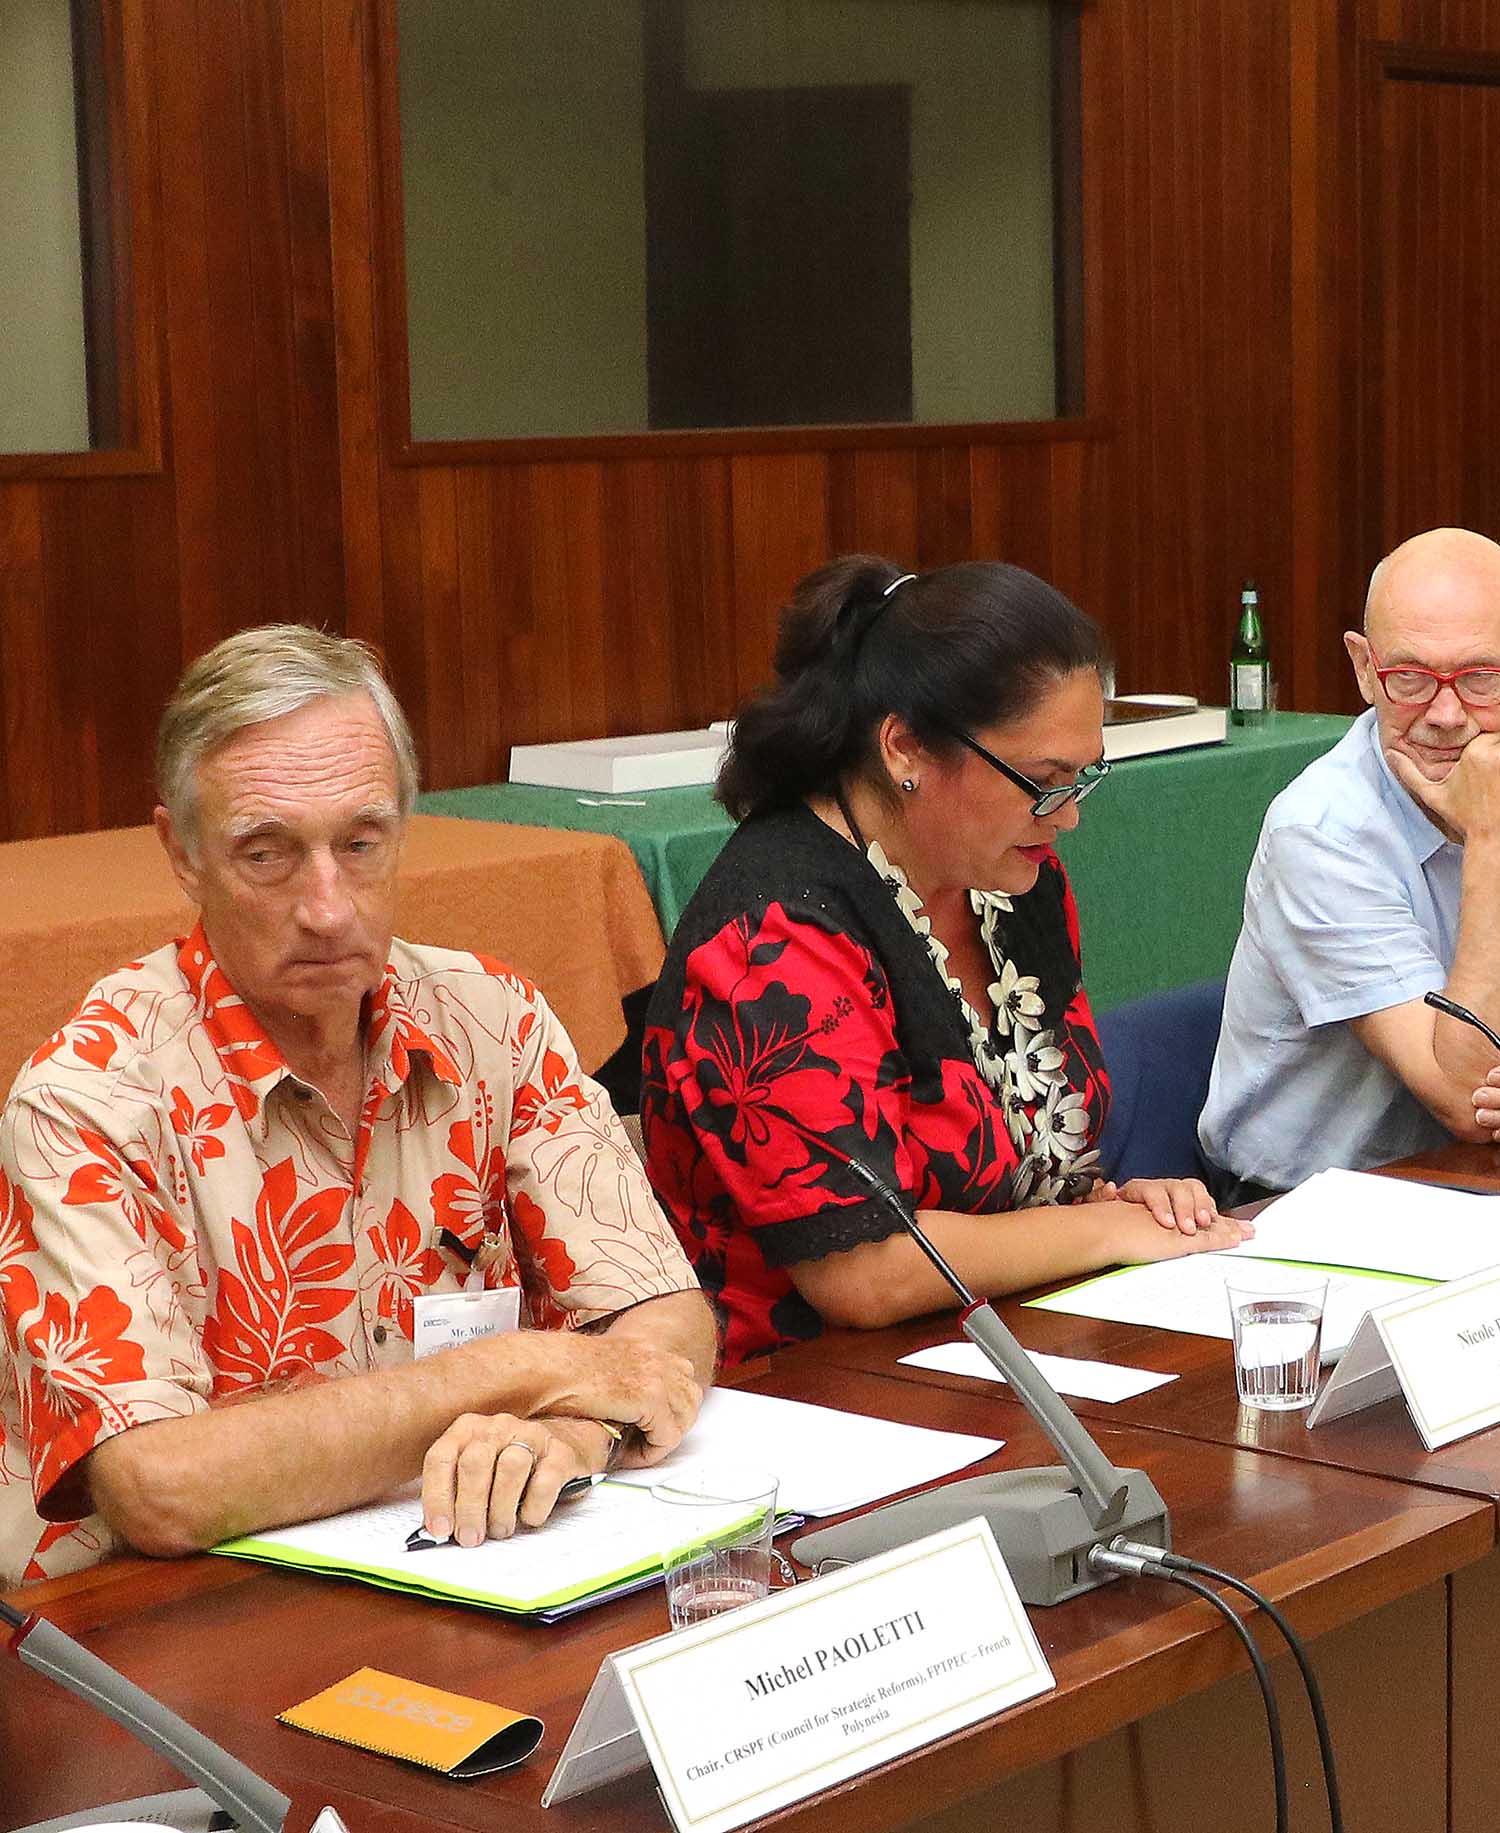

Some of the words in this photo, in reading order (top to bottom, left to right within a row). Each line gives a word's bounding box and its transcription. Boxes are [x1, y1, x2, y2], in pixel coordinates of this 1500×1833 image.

[451, 1328, 467, 1338] Mr.
[1456, 1321, 1496, 1350] Nicole
[743, 1655, 814, 1702] Michel
[816, 1609, 928, 1673] PAOLETTI
[686, 1757, 725, 1783] Chair,
[724, 1740, 767, 1768] CRSPF
[767, 1720, 814, 1751] (Council
[813, 1712, 831, 1731] for
[830, 1692, 878, 1726] Strategic
[877, 1671, 927, 1706] Reforms),
[925, 1654, 970, 1685] FPTPEC
[977, 1634, 1012, 1664] French
[841, 1708, 891, 1738] Polynesia
